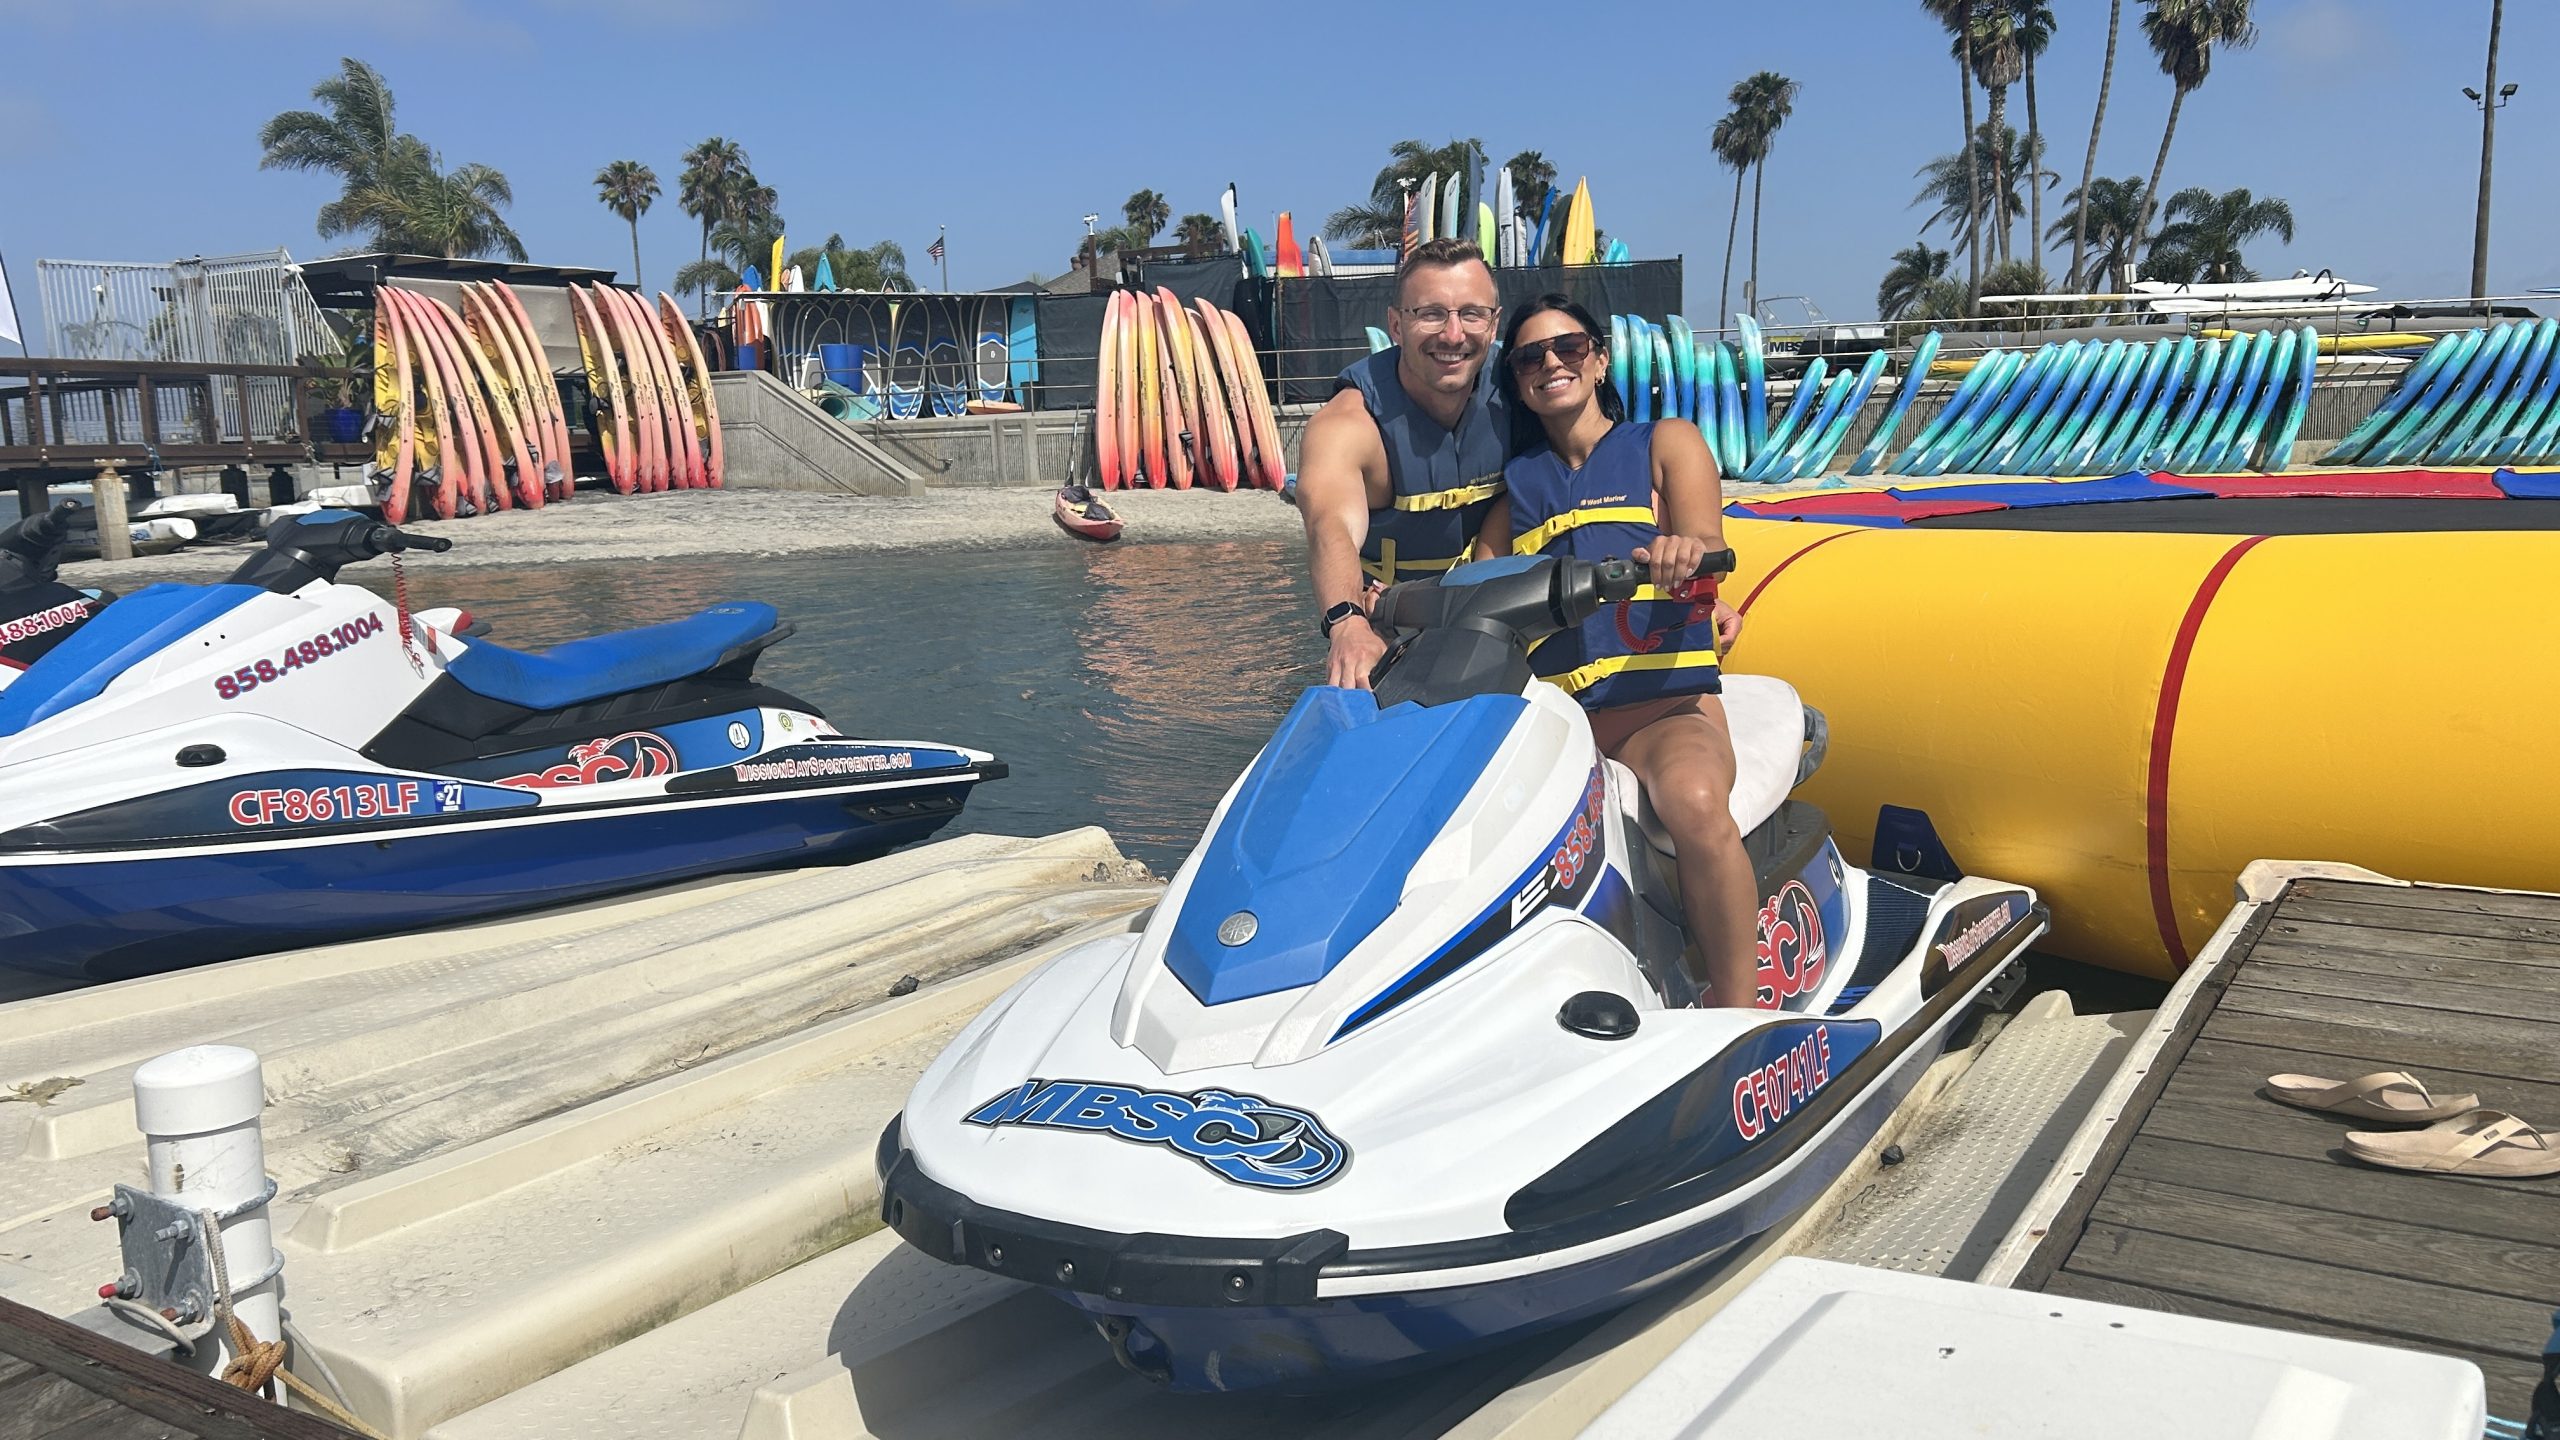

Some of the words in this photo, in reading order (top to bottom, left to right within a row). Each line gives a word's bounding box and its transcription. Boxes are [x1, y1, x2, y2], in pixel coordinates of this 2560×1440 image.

[214, 611, 385, 700] 858.488.1004
[229, 782, 419, 826] CF8613LF
[443, 784, 463, 806] 27
[1733, 1024, 1830, 1141] CF0741LF
